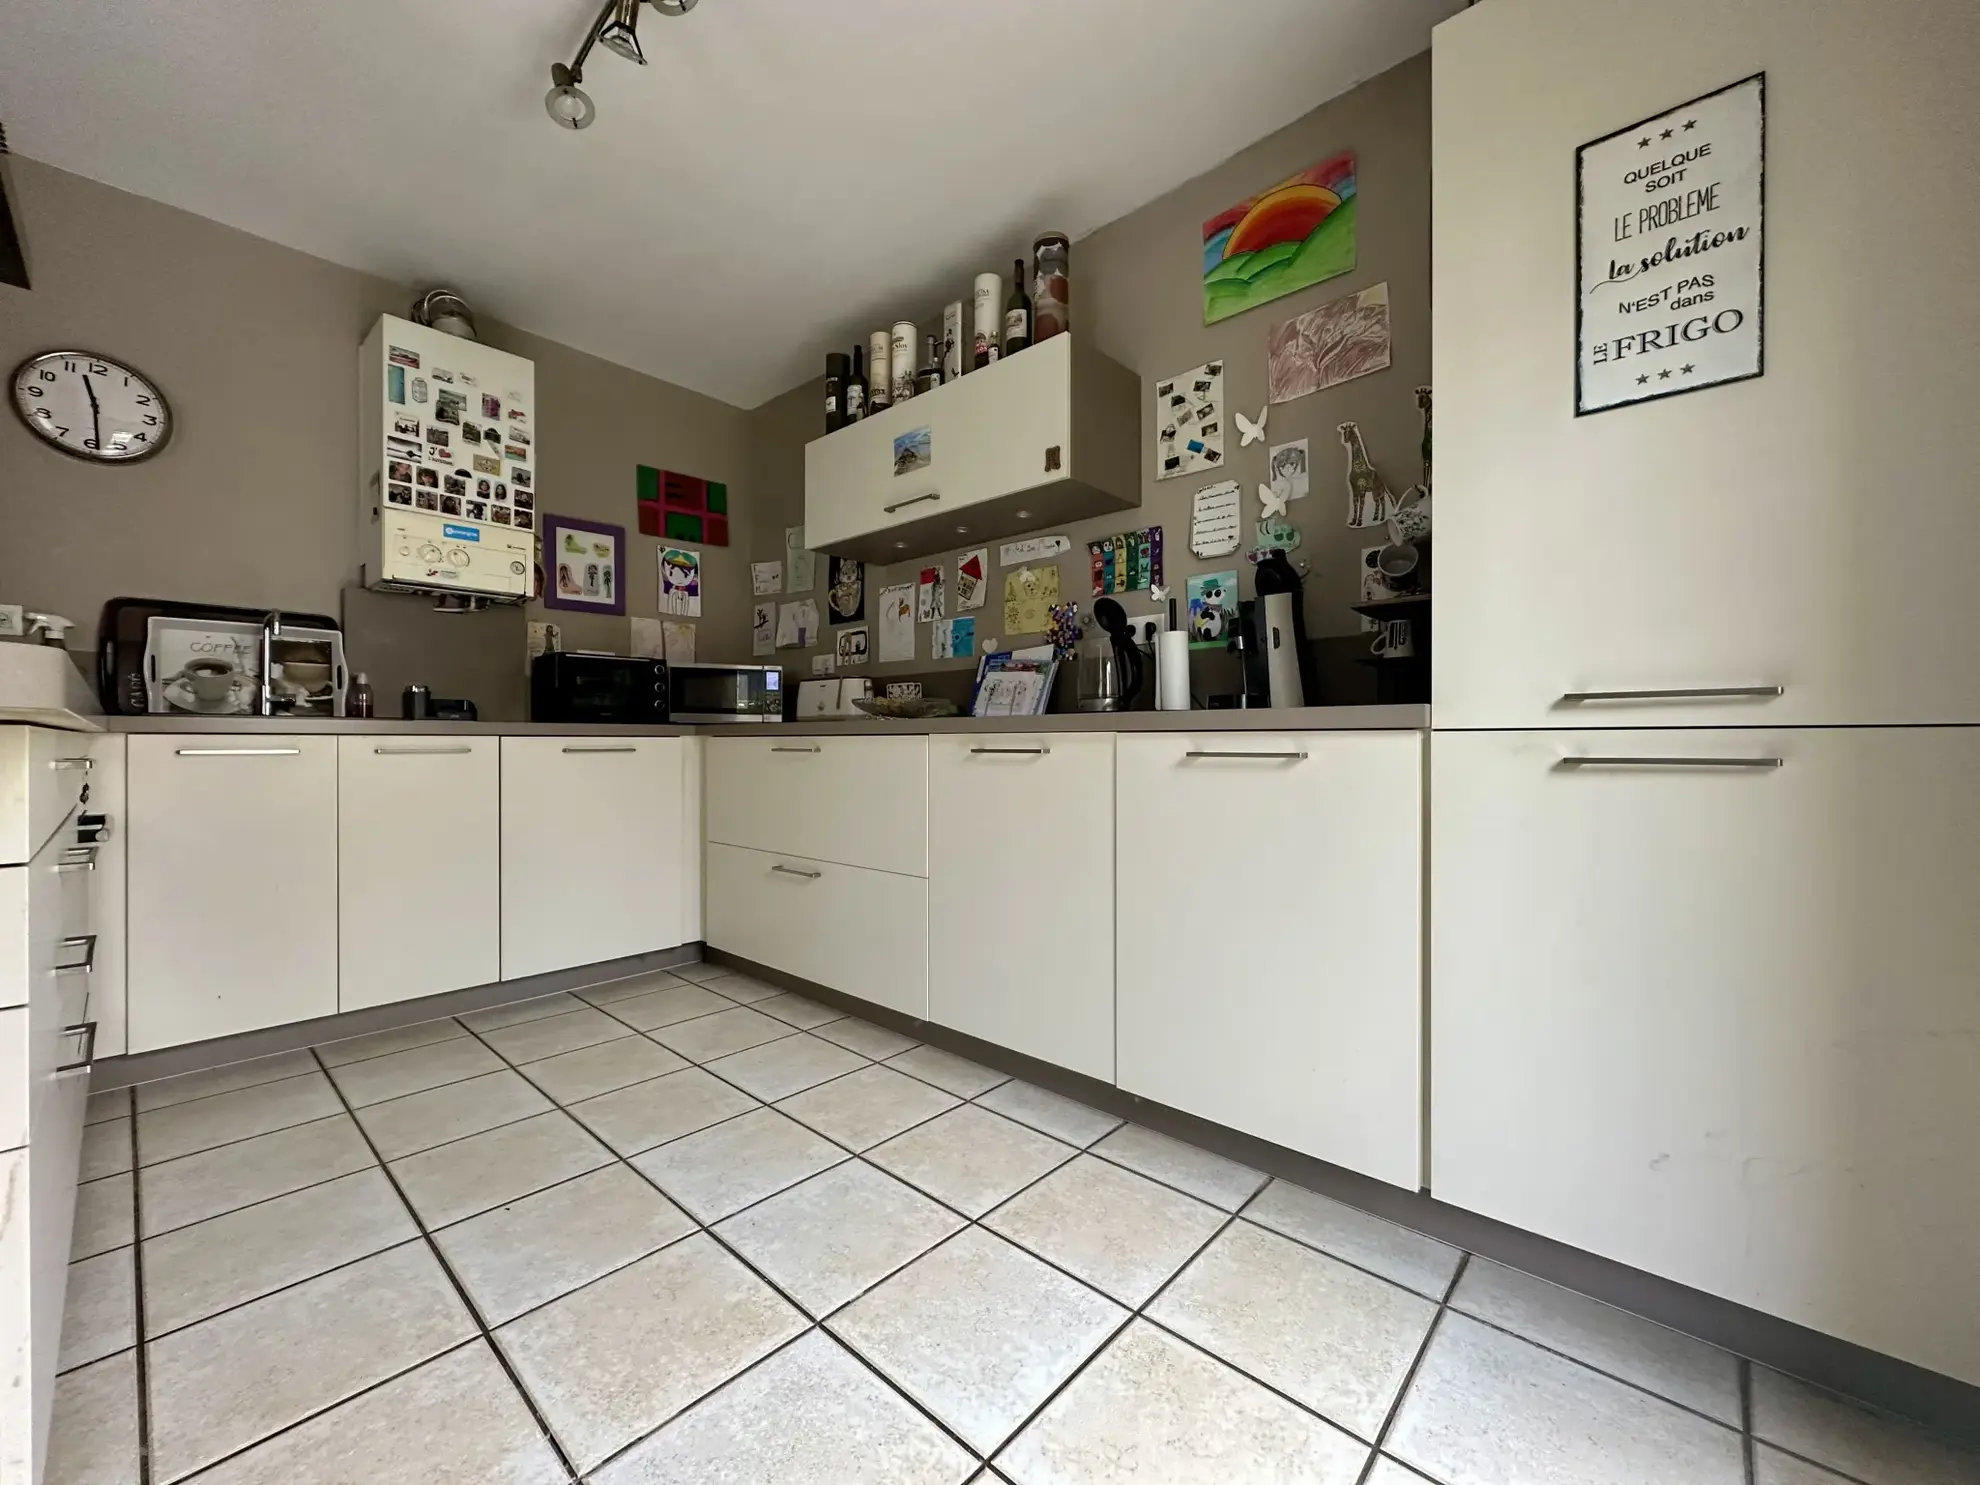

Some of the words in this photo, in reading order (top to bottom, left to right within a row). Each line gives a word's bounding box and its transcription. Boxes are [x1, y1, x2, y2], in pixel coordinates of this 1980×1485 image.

[1623, 143, 1712, 185] QUELQUE
[1645, 168, 1688, 193] SOIT
[1614, 212, 1632, 242] LE
[1639, 182, 1721, 234] PROBLEME
[1640, 225, 1750, 273] solution
[1676, 274, 1715, 295] PAS
[1670, 291, 1715, 311] dans
[1592, 342, 1608, 366] LE
[1612, 307, 1744, 361] FRIGO
[64, 361, 76, 373] 11
[88, 362, 109, 377] 12
[39, 369, 56, 382] 10
[123, 376, 129, 387] 1
[27, 386, 44, 397] 9
[136, 394, 151, 407] 2
[34, 407, 52, 419] 8
[142, 414, 157, 426] 3
[56, 426, 69, 437] 7
[133, 432, 148, 442] 4
[83, 438, 97, 450] 6
[190, 642, 252, 655] COFFEE
